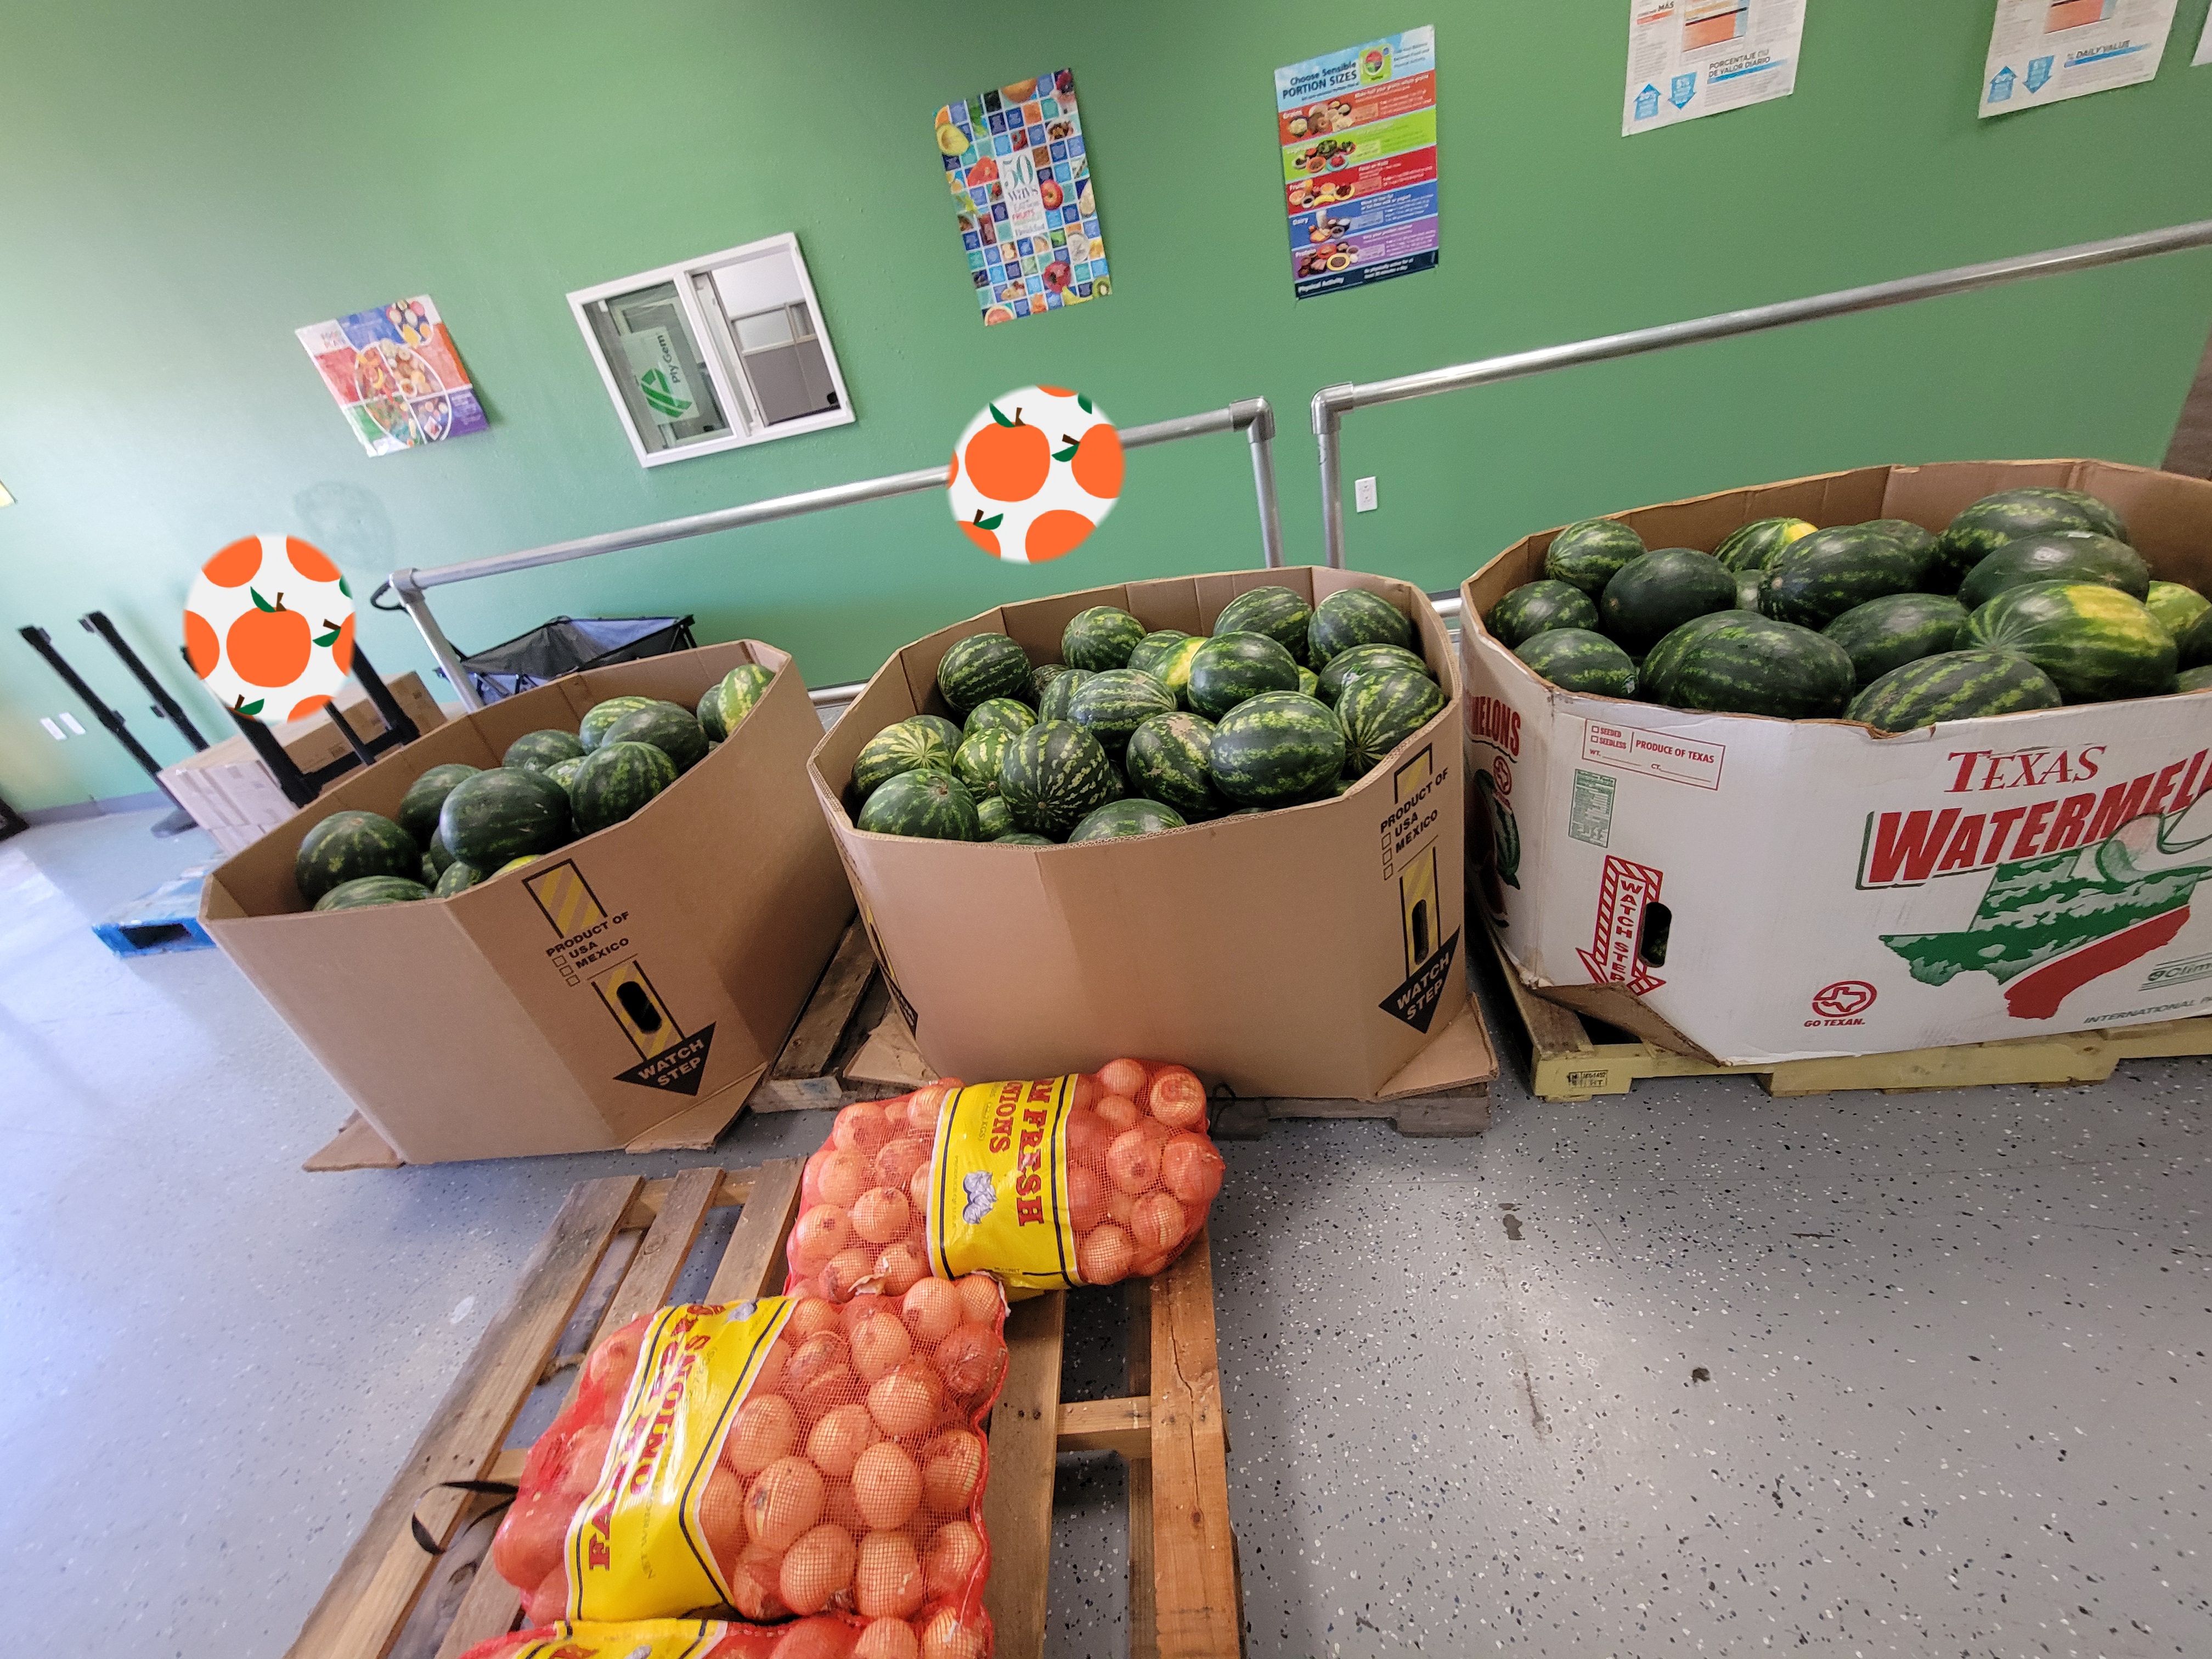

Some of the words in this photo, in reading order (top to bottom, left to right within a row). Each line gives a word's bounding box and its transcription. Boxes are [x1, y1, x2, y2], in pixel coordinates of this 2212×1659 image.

[1709, 52, 1756, 70] PORCENTAJE
[1720, 63, 1743, 75] VALOR
[1745, 57, 1770, 69] DIARIO
[2076, 46, 2102, 59] DAILY
[1282, 78, 1327, 99] PORTION
[1329, 69, 1357, 86] SIZES
[1290, 72, 1320, 86] Choose
[1322, 61, 1357, 77] Sensible
[1002, 154, 1034, 190] 50
[1599, 737, 1627, 750] SEEDLESS
[1600, 727, 1622, 738] SEEDED
[1635, 740, 1673, 755] PRODUCE
[1674, 748, 1687, 758] OF
[1688, 751, 1715, 764] TEXAS
[1944, 744, 2107, 794] TEXAS
[1380, 780, 1434, 834] PRODUCT
[1434, 767, 1449, 787] OF
[1394, 814, 1419, 837] USA
[1395, 809, 1438, 853] MEXICO
[1615, 880, 1643, 939] WATCH
[545, 922, 610, 957] PRODUCT
[612, 911, 630, 925] OF
[568, 940, 599, 960] USA
[575, 937, 630, 969] MEXICO
[1610, 941, 1629, 982] STEP
[1396, 951, 1450, 1011] WATCH
[1406, 979, 1444, 1020] STEP
[2083, 999, 2194, 1024] INTERNATIONAL
[637, 1039, 705, 1080] WATCH
[657, 1057, 702, 1086] STEP
[1016, 1108, 1048, 1227] FRESH
[630, 1334, 712, 1495] ONIONS
